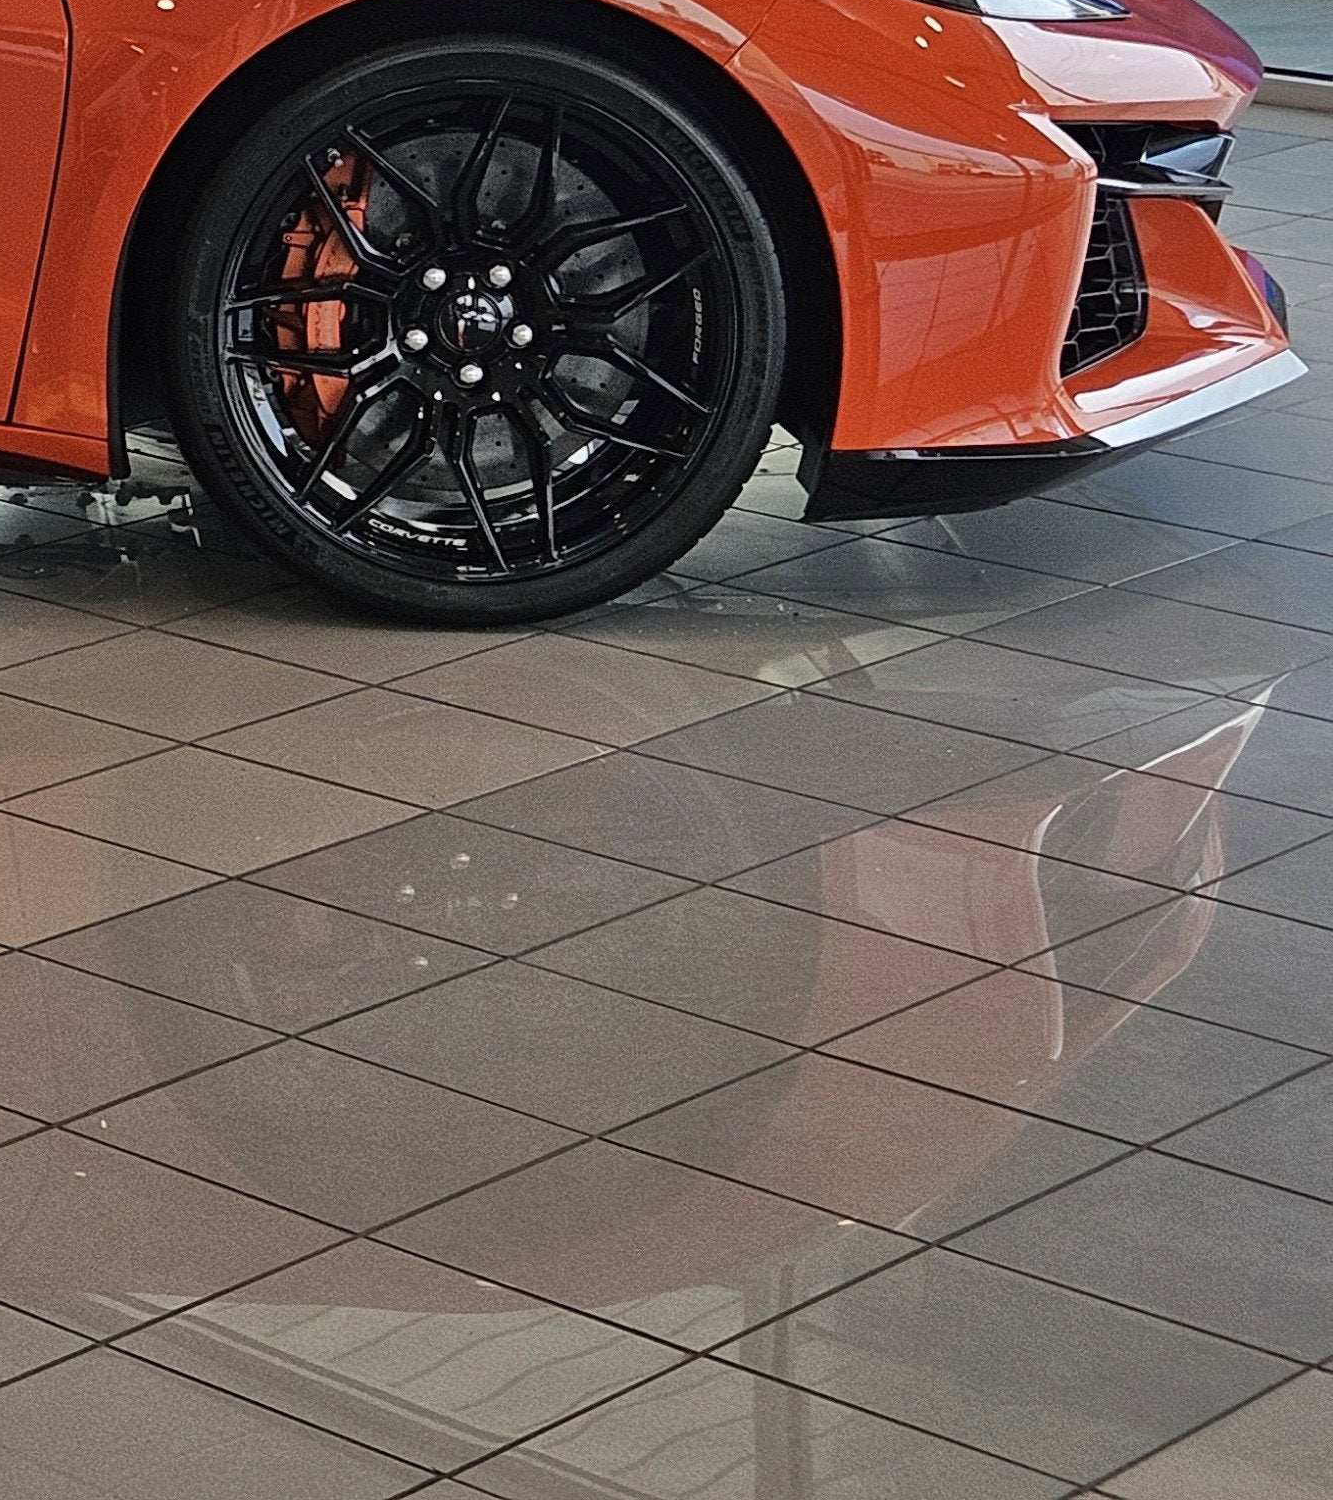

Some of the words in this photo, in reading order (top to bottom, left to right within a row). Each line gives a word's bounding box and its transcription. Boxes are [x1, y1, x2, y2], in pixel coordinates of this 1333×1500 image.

[692, 287, 703, 365] FORGED
[208, 429, 290, 536] MICHELIN
[367, 518, 468, 547] CORVETTE
